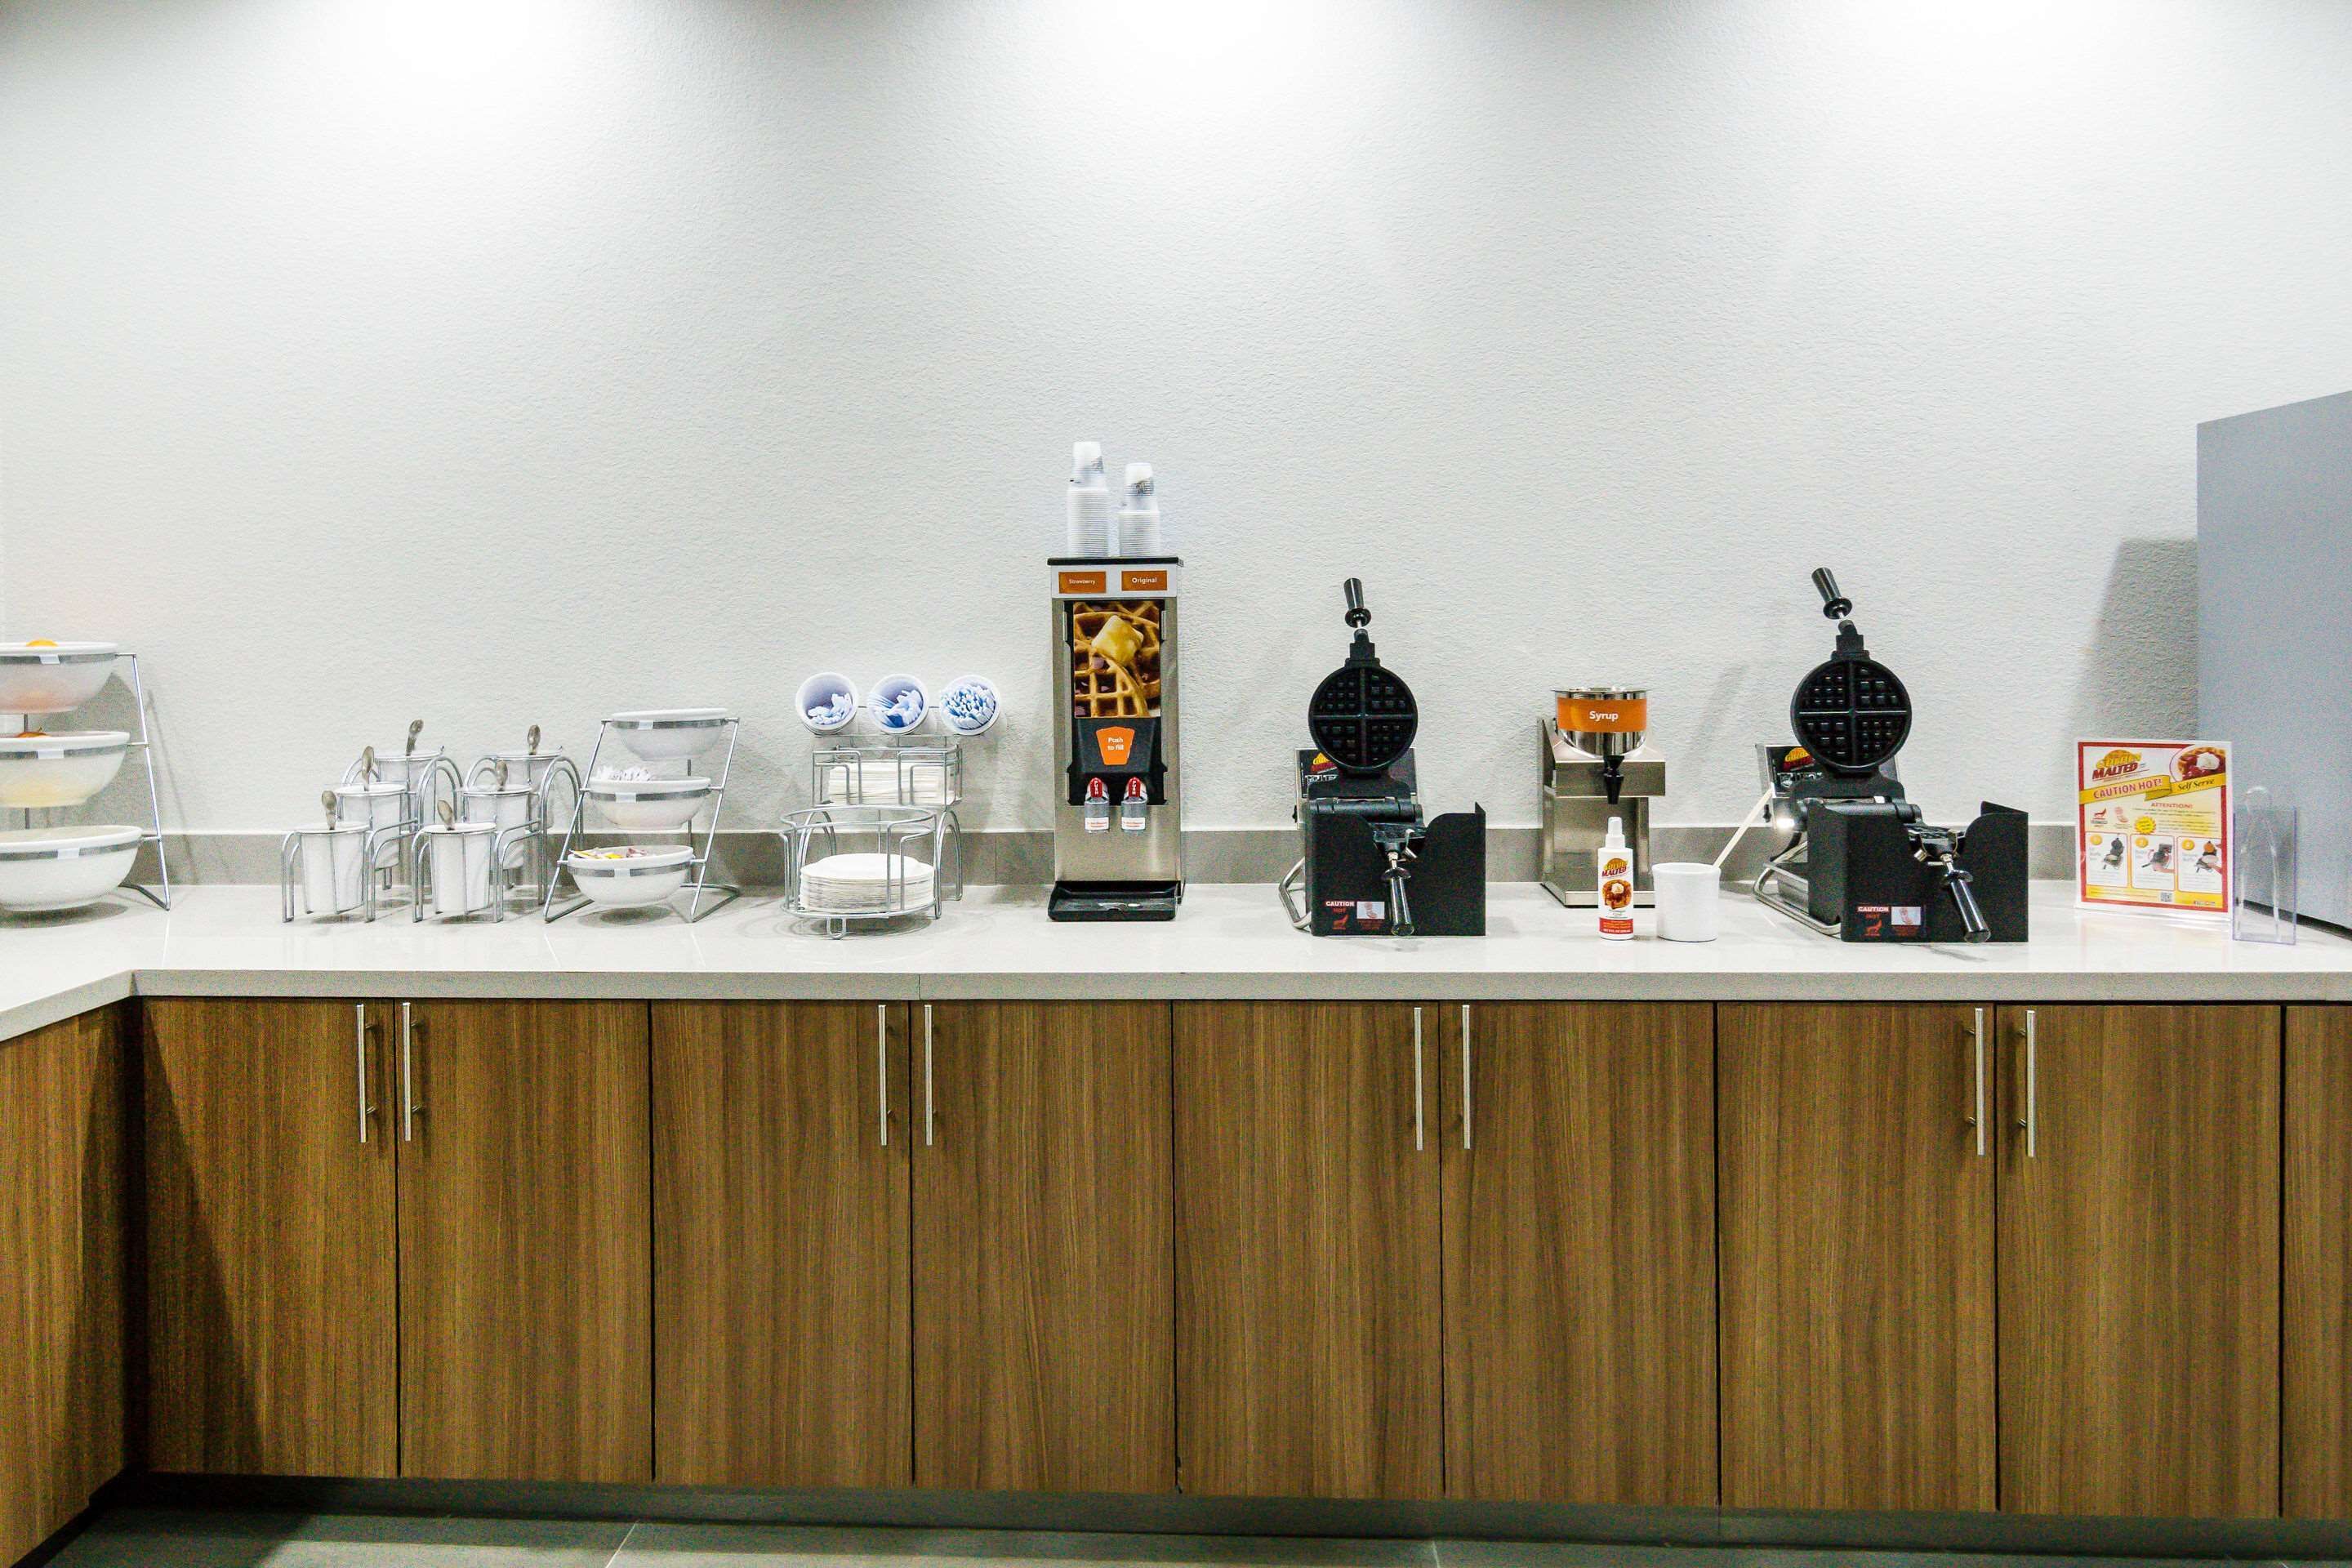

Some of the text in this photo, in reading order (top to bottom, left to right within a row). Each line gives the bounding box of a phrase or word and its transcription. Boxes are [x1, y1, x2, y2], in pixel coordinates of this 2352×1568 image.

[1589, 710, 1619, 722] Syrup
[2092, 763, 2138, 779] MALTED
[2093, 778, 2162, 799] CAUTION HOT!
[2178, 779, 2215, 790] Self Serve
[1601, 866, 1627, 876] MALTED
